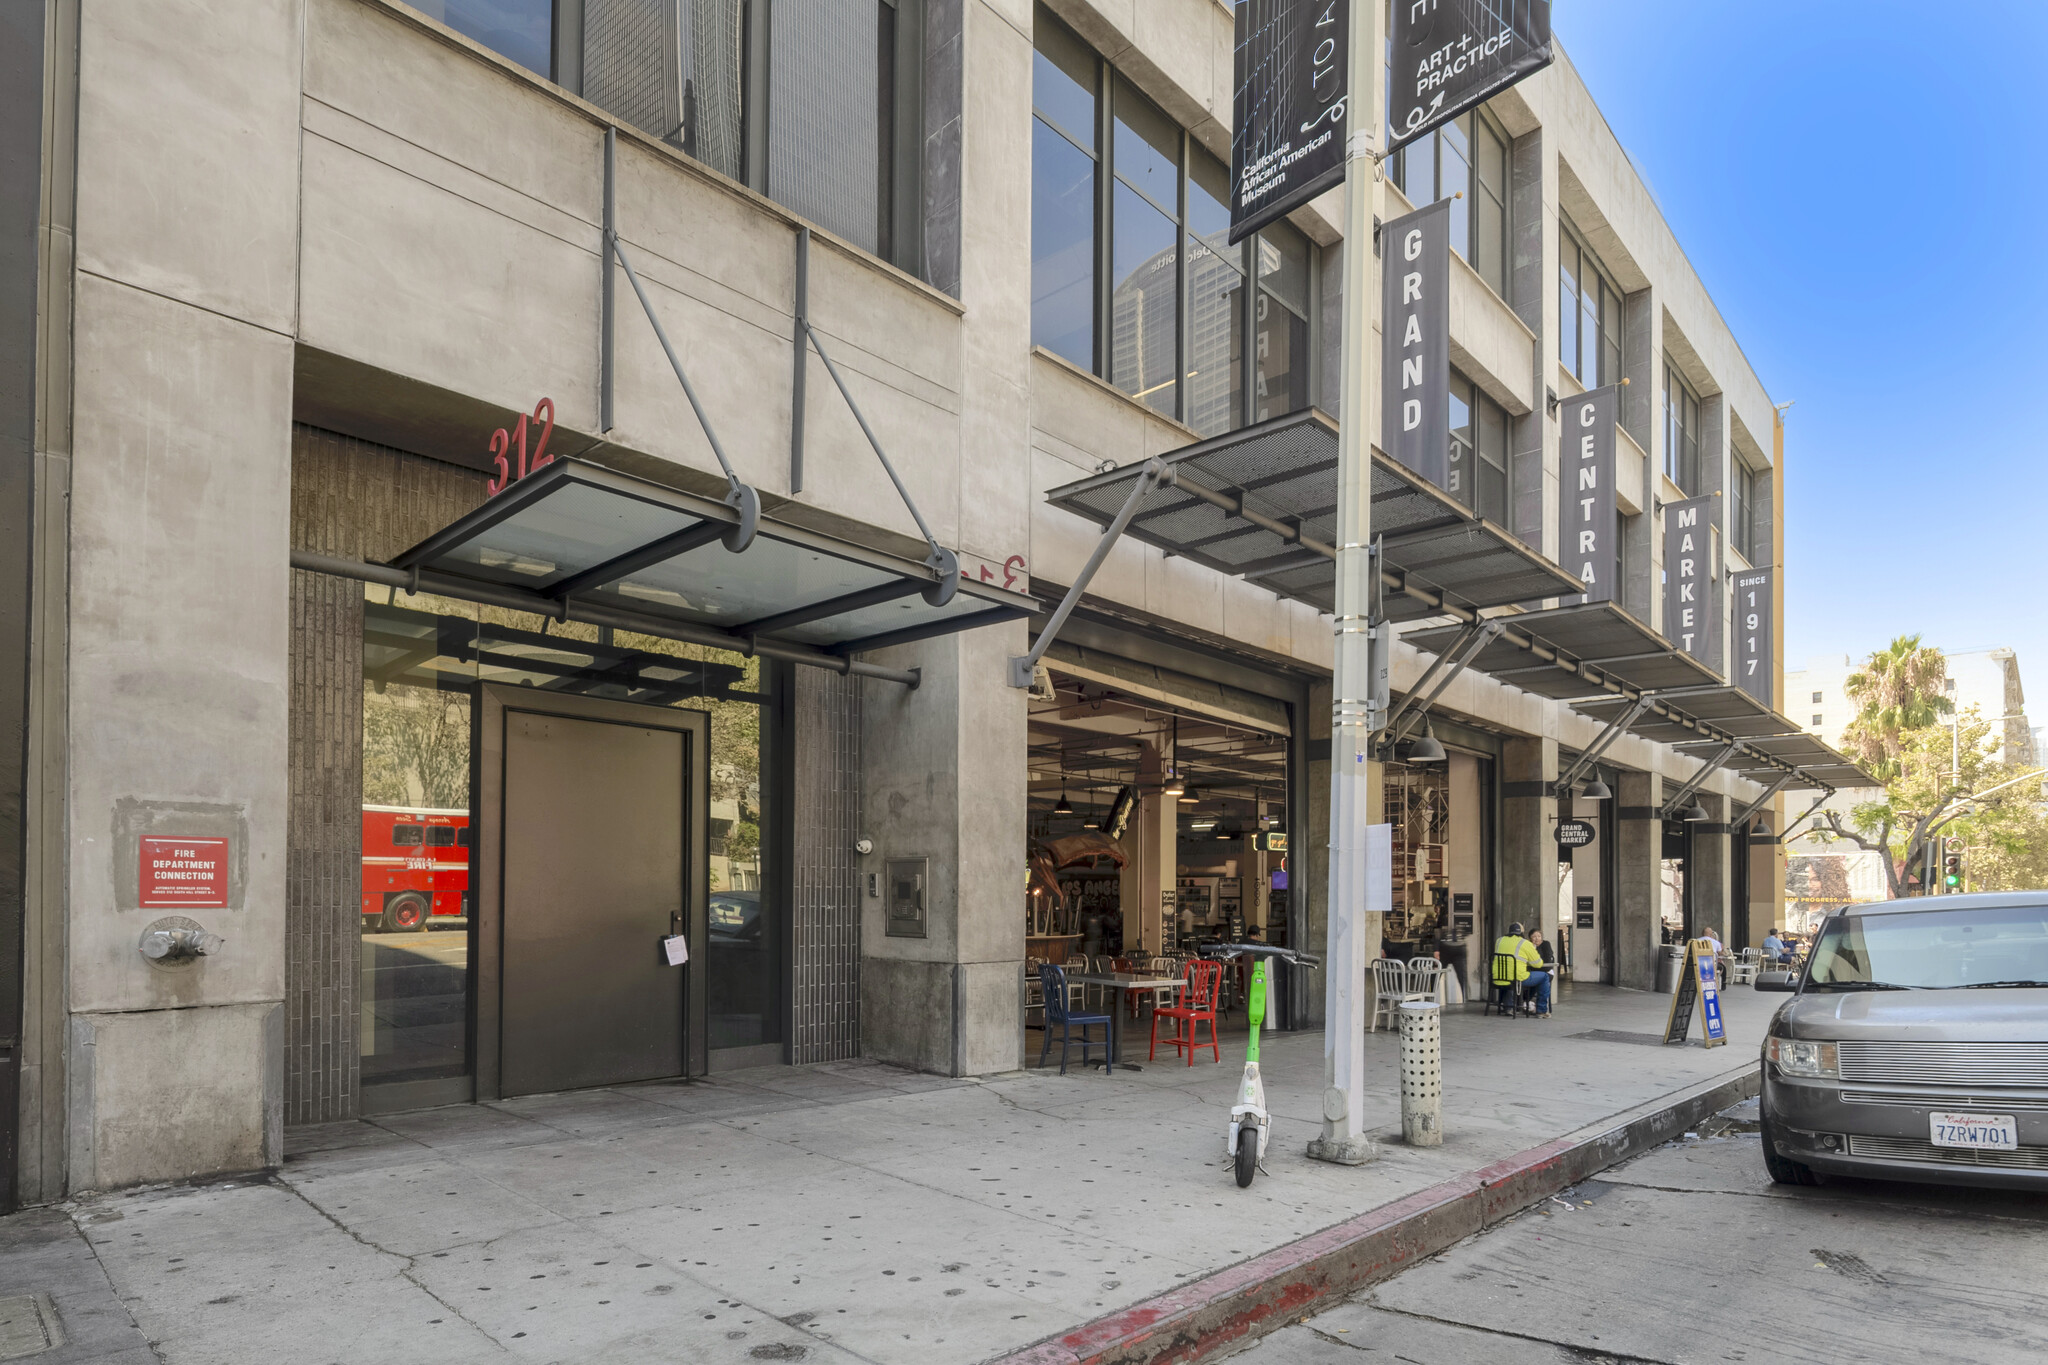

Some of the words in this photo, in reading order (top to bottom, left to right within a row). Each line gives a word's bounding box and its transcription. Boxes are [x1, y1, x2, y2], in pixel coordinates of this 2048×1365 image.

[1416, 27, 1512, 97] PRACTICE
[1417, 41, 1454, 78] ART
[1241, 164, 1277, 194] African
[1279, 130, 1332, 170] American
[1242, 142, 1290, 179] California
[1241, 172, 1286, 207] Museum
[1402, 229, 1423, 432] GRAND
[487, 397, 554, 497] 312
[1678, 507, 1697, 652] MARKET
[1739, 576, 1766, 587] SINCE
[1746, 591, 1759, 676] 1917
[153, 860, 216, 869] DEPARTMENT
[174, 849, 196, 858] FIRE
[154, 871, 214, 880] CONNECTION
[1084, 879, 1121, 896] ANGE
[1936, 1125, 2011, 1144] 7ZRW701
[1947, 1115, 1999, 1126] California
